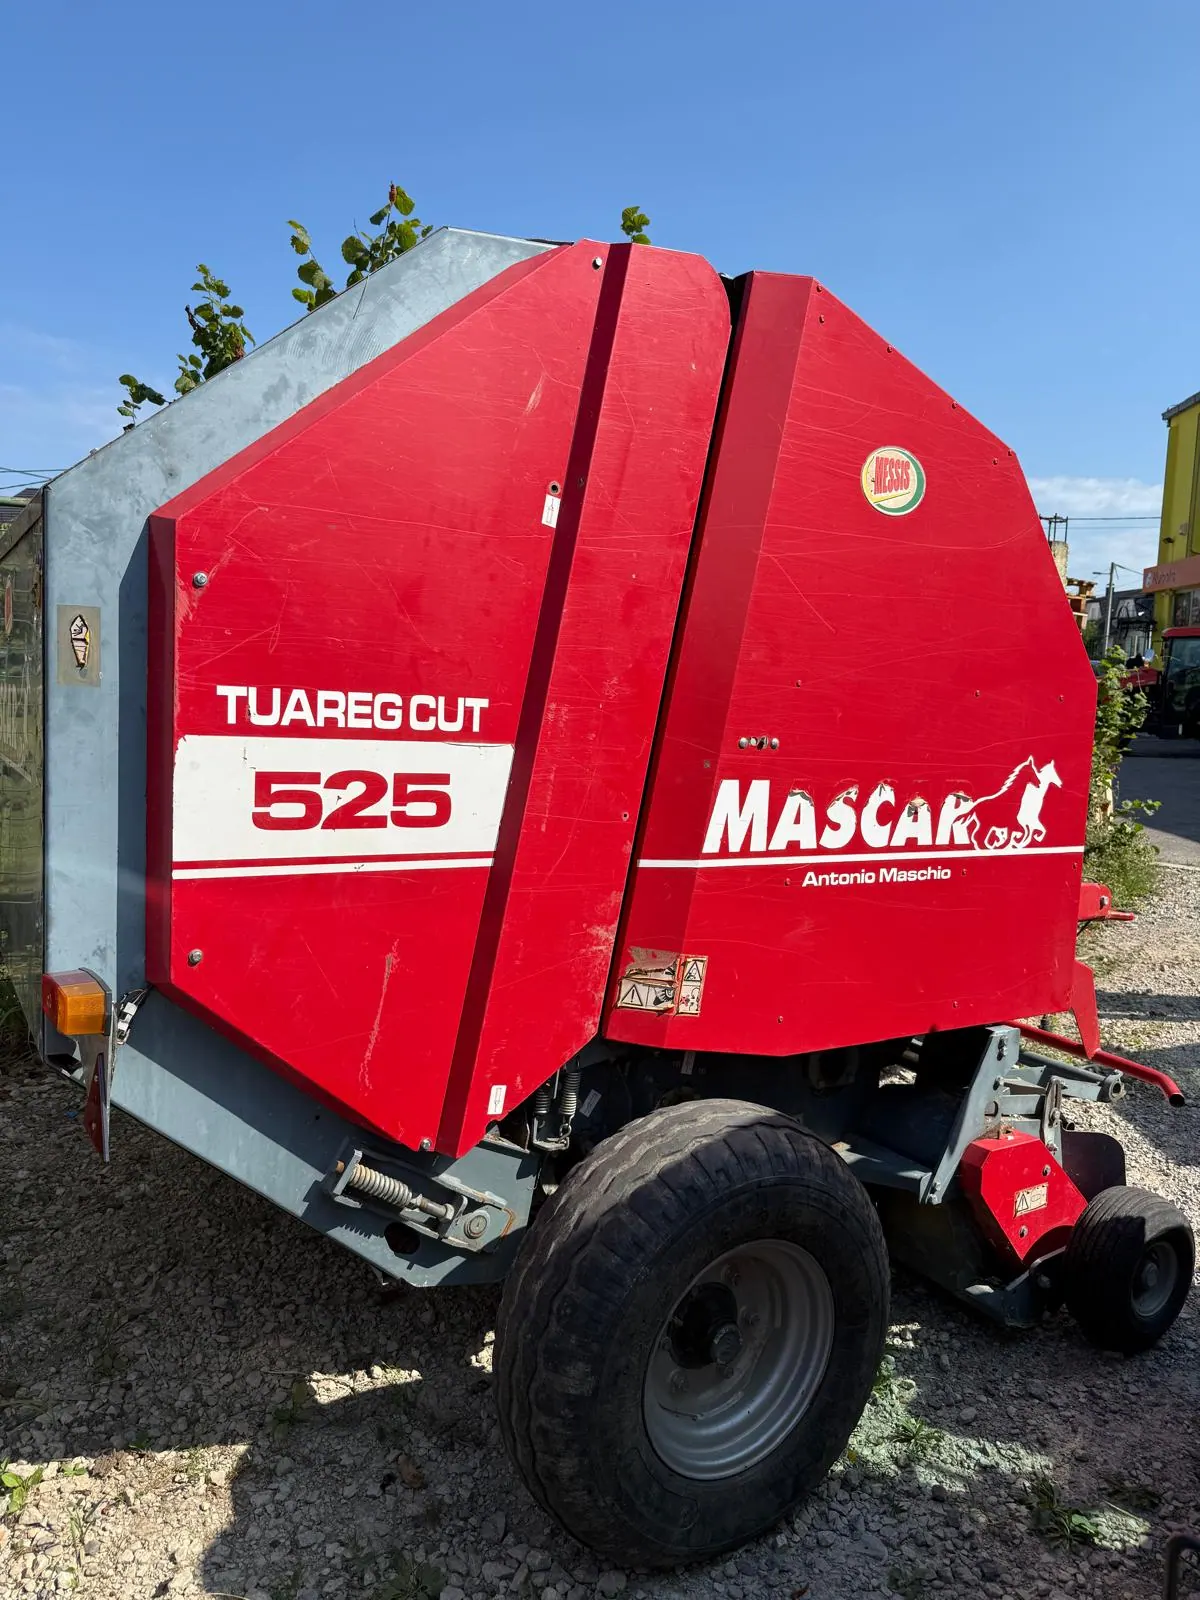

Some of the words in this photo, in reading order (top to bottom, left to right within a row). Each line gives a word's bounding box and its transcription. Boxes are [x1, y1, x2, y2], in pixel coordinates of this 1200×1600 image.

[216, 685, 403, 730] TUAREG
[409, 694, 490, 732] CUT
[251, 769, 452, 831] 525
[701, 779, 973, 854] MASCAR
[801, 869, 876, 888] Antonio
[879, 865, 951, 883] Maschio
